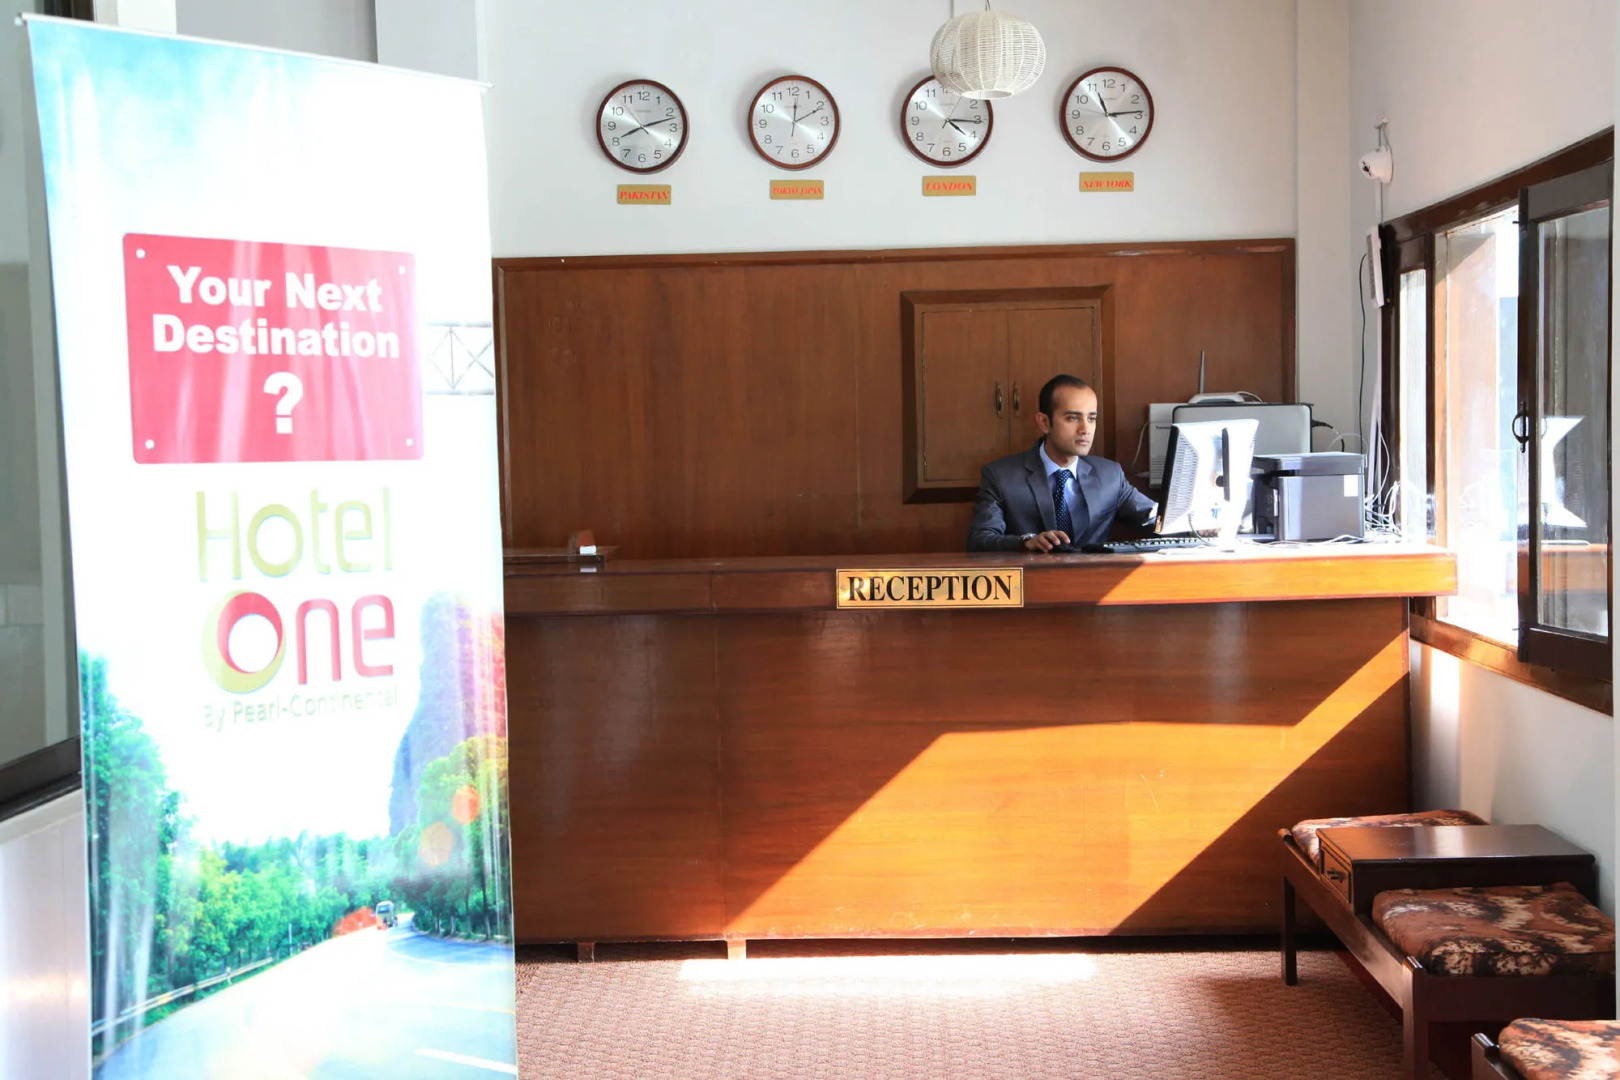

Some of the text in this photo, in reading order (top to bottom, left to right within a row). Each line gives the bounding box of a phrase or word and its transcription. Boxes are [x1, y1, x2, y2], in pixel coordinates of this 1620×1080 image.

[1087, 83, 1097, 91] 11
[1102, 79, 1115, 88] 12
[1121, 84, 1125, 92] 1
[638, 92, 650, 100] 12
[772, 92, 782, 100] 11
[787, 87, 800, 96] 12
[806, 91, 810, 99] 1
[925, 89, 936, 97] 11
[623, 95, 633, 104] 11
[656, 96, 660, 104] 1
[1076, 95, 1088, 104] 10
[1131, 95, 1140, 104] 2
[762, 104, 774, 113] 10
[816, 101, 824, 110] 2
[914, 101, 927, 110] 10
[970, 100, 978, 109] 2
[612, 106, 624, 116] 10
[666, 108, 674, 117] 2
[1072, 110, 1080, 119] 9
[1134, 111, 1143, 119] 3
[759, 119, 767, 128] 9
[821, 116, 829, 125] 3
[911, 116, 919, 125] 9
[974, 115, 982, 124] 3
[608, 121, 616, 130] 9
[670, 123, 677, 132] 3
[1129, 126, 1137, 134] 4
[1076, 126, 1084, 135] 8
[764, 135, 772, 144] 8
[817, 133, 824, 141] 4
[916, 132, 924, 141] 8
[612, 137, 620, 146] 8
[664, 139, 672, 147] 4
[1087, 138, 1095, 146] 7
[1102, 142, 1110, 150] 6
[1118, 138, 1126, 147] 5
[776, 146, 783, 154] 7
[807, 145, 814, 154] 5
[927, 143, 935, 152] 7
[943, 147, 951, 156] 6
[958, 143, 966, 152] 5
[623, 149, 631, 158] 7
[638, 154, 646, 162] 6
[654, 150, 661, 159] 5
[791, 149, 799, 158] 6
[925, 182, 973, 192] LONDON
[1083, 180, 1131, 188] NEW YORK
[619, 191, 669, 200] PAKISTAN
[167, 265, 383, 313] Your Next
[152, 313, 400, 359] Destination
[263, 372, 304, 434] ?
[195, 486, 394, 582] Hotel
[847, 574, 1012, 601] RECEPTION
[203, 588, 396, 695] One
[204, 682, 398, 732] By Pearl-Contneal
